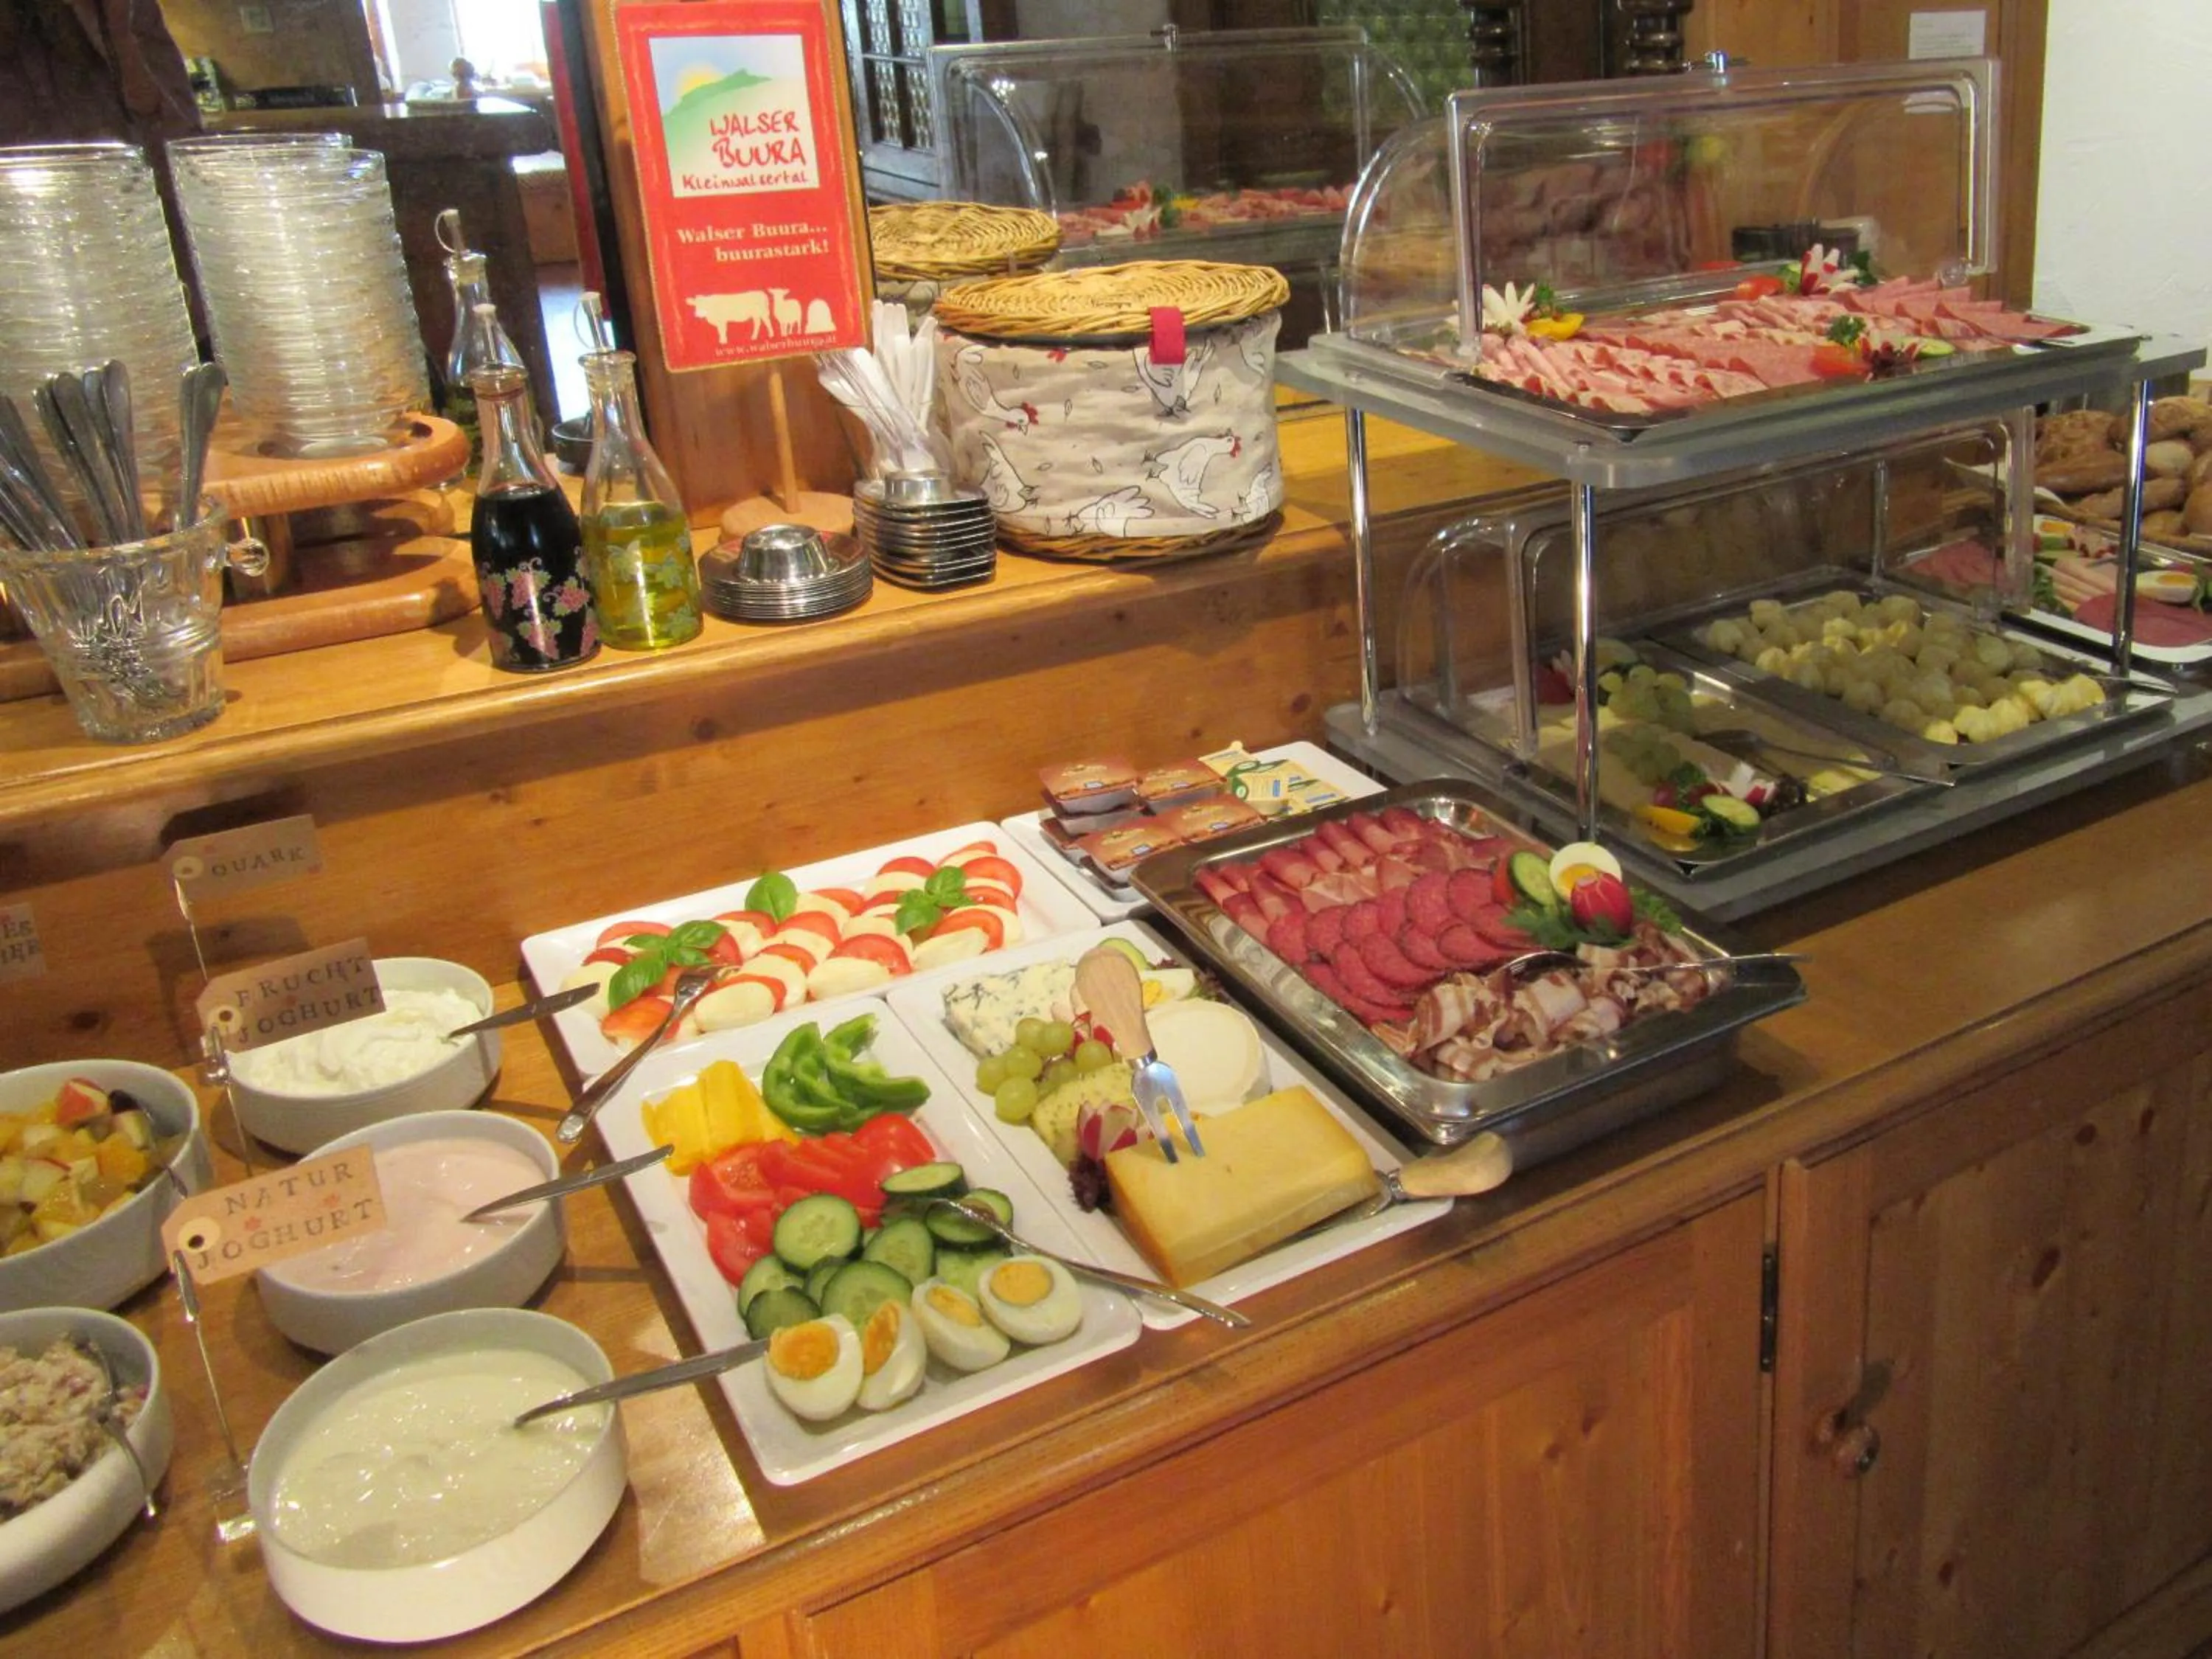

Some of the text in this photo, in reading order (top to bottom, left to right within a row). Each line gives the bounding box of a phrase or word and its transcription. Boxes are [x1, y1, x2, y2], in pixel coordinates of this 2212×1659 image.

[709, 110, 800, 138] WALSER
[712, 136, 807, 169] BUURA
[681, 170, 809, 191] Kleinwalsertal
[677, 222, 828, 244] Walser Buura...
[714, 238, 830, 263] buurastark!
[211, 846, 306, 878] QUARK
[234, 956, 366, 1008] FRUCHT
[238, 987, 380, 1044] JOGHURT
[224, 1162, 354, 1216] NATUR
[197, 1197, 374, 1270] JOGHURT
